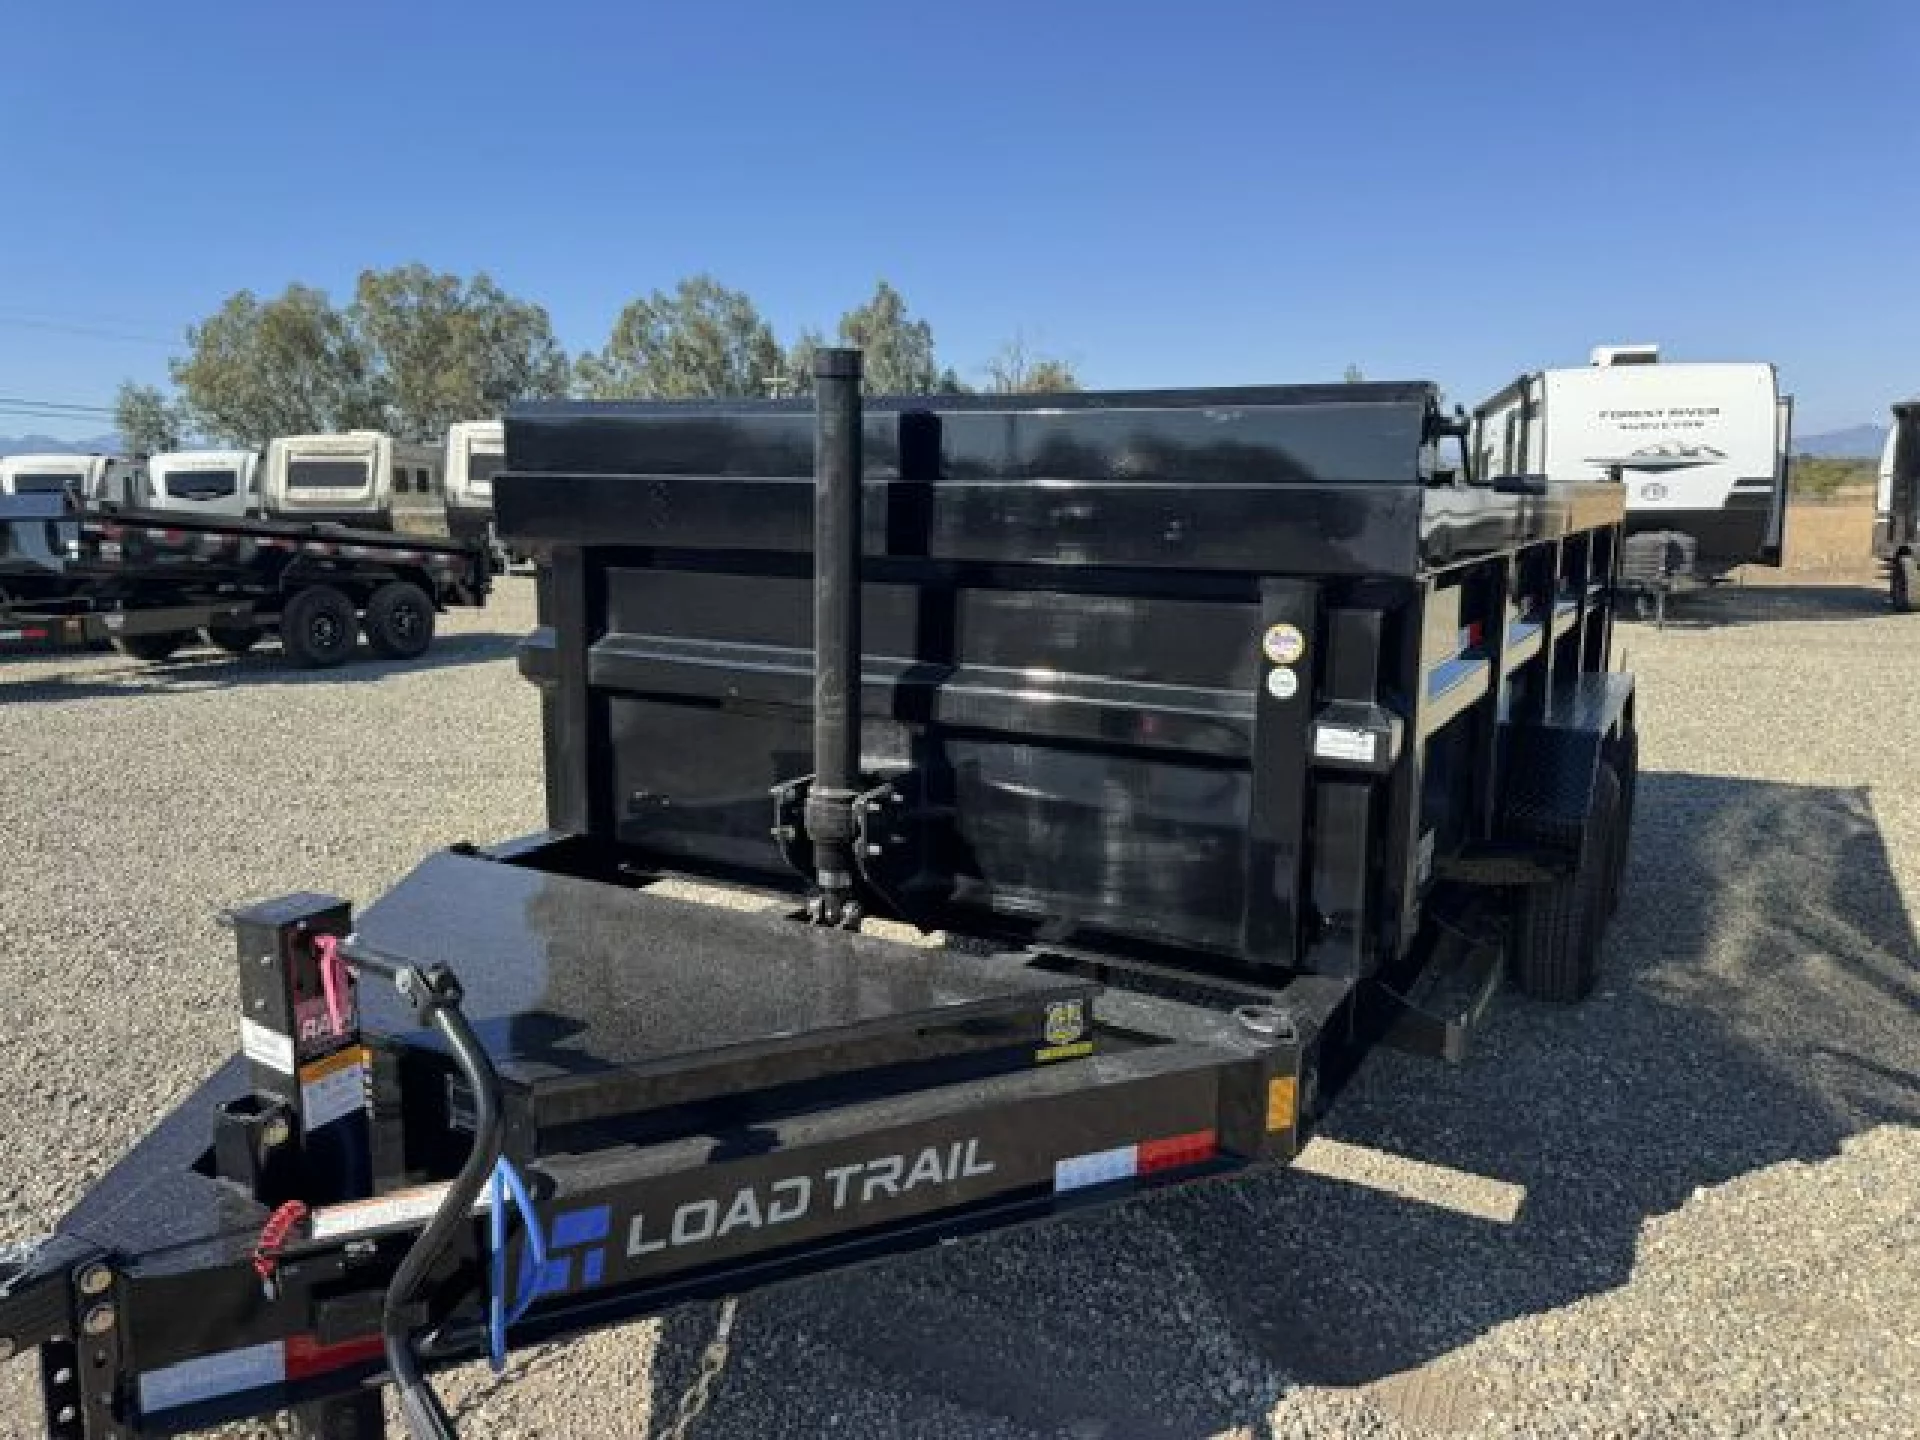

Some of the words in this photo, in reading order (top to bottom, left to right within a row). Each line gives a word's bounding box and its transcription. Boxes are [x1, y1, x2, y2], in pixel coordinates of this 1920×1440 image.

[1599, 408, 1663, 420] FOREST
[1668, 407, 1720, 419] RIVER
[626, 1175, 813, 1258] LOAD
[825, 1138, 996, 1210] TRAIL
